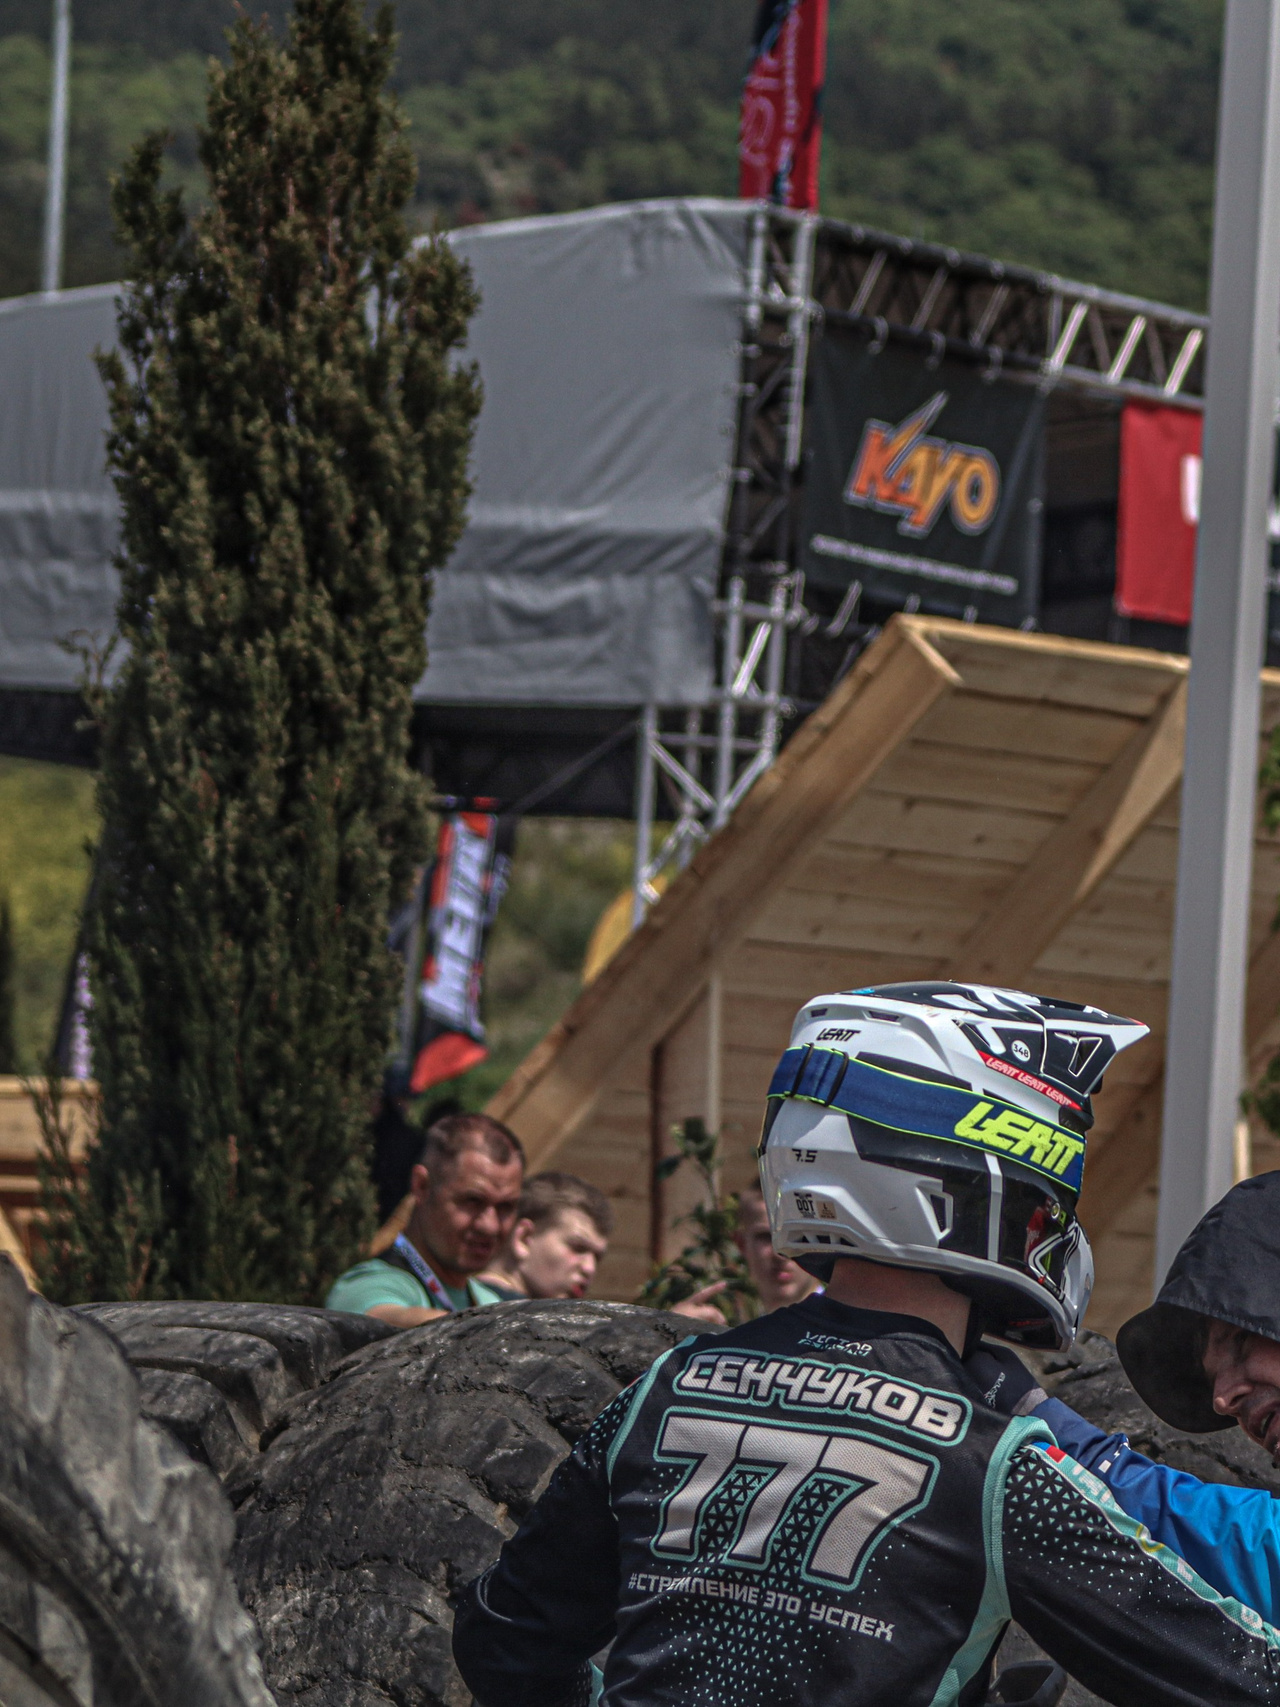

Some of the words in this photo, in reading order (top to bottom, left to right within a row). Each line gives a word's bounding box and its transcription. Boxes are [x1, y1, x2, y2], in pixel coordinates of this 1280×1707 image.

[847, 395, 999, 537] KAYO
[816, 1028, 861, 1042] LEATT
[1013, 1043, 1029, 1058] 348
[986, 1057, 1020, 1078] LEATT
[1017, 1071, 1048, 1092] LEATT
[1045, 1087, 1072, 1106] LEATT
[792, 1148, 818, 1163] 7.5
[953, 1101, 1085, 1176] LEATT
[677, 1354, 964, 1440] СЕНЧУКОВ
[654, 1411, 931, 1582] 777
[762, 1590, 801, 1614] ЭТО
[809, 1602, 896, 1642] УСПЕХ
